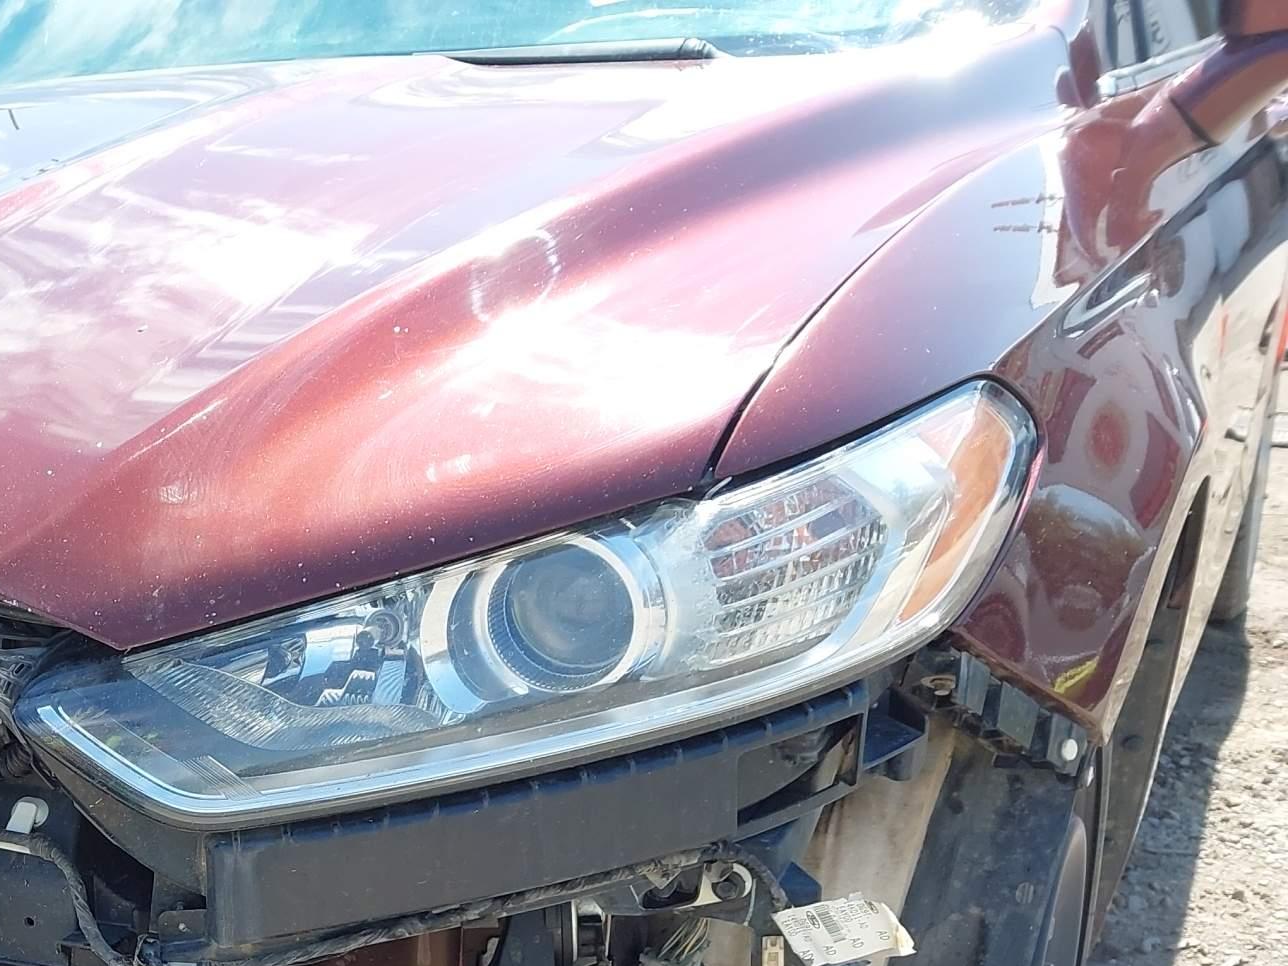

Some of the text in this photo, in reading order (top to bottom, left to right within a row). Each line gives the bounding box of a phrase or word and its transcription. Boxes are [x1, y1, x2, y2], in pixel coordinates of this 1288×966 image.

[876, 930, 890, 941] AD
[850, 937, 865, 949] AD
[824, 945, 837, 956] AD
